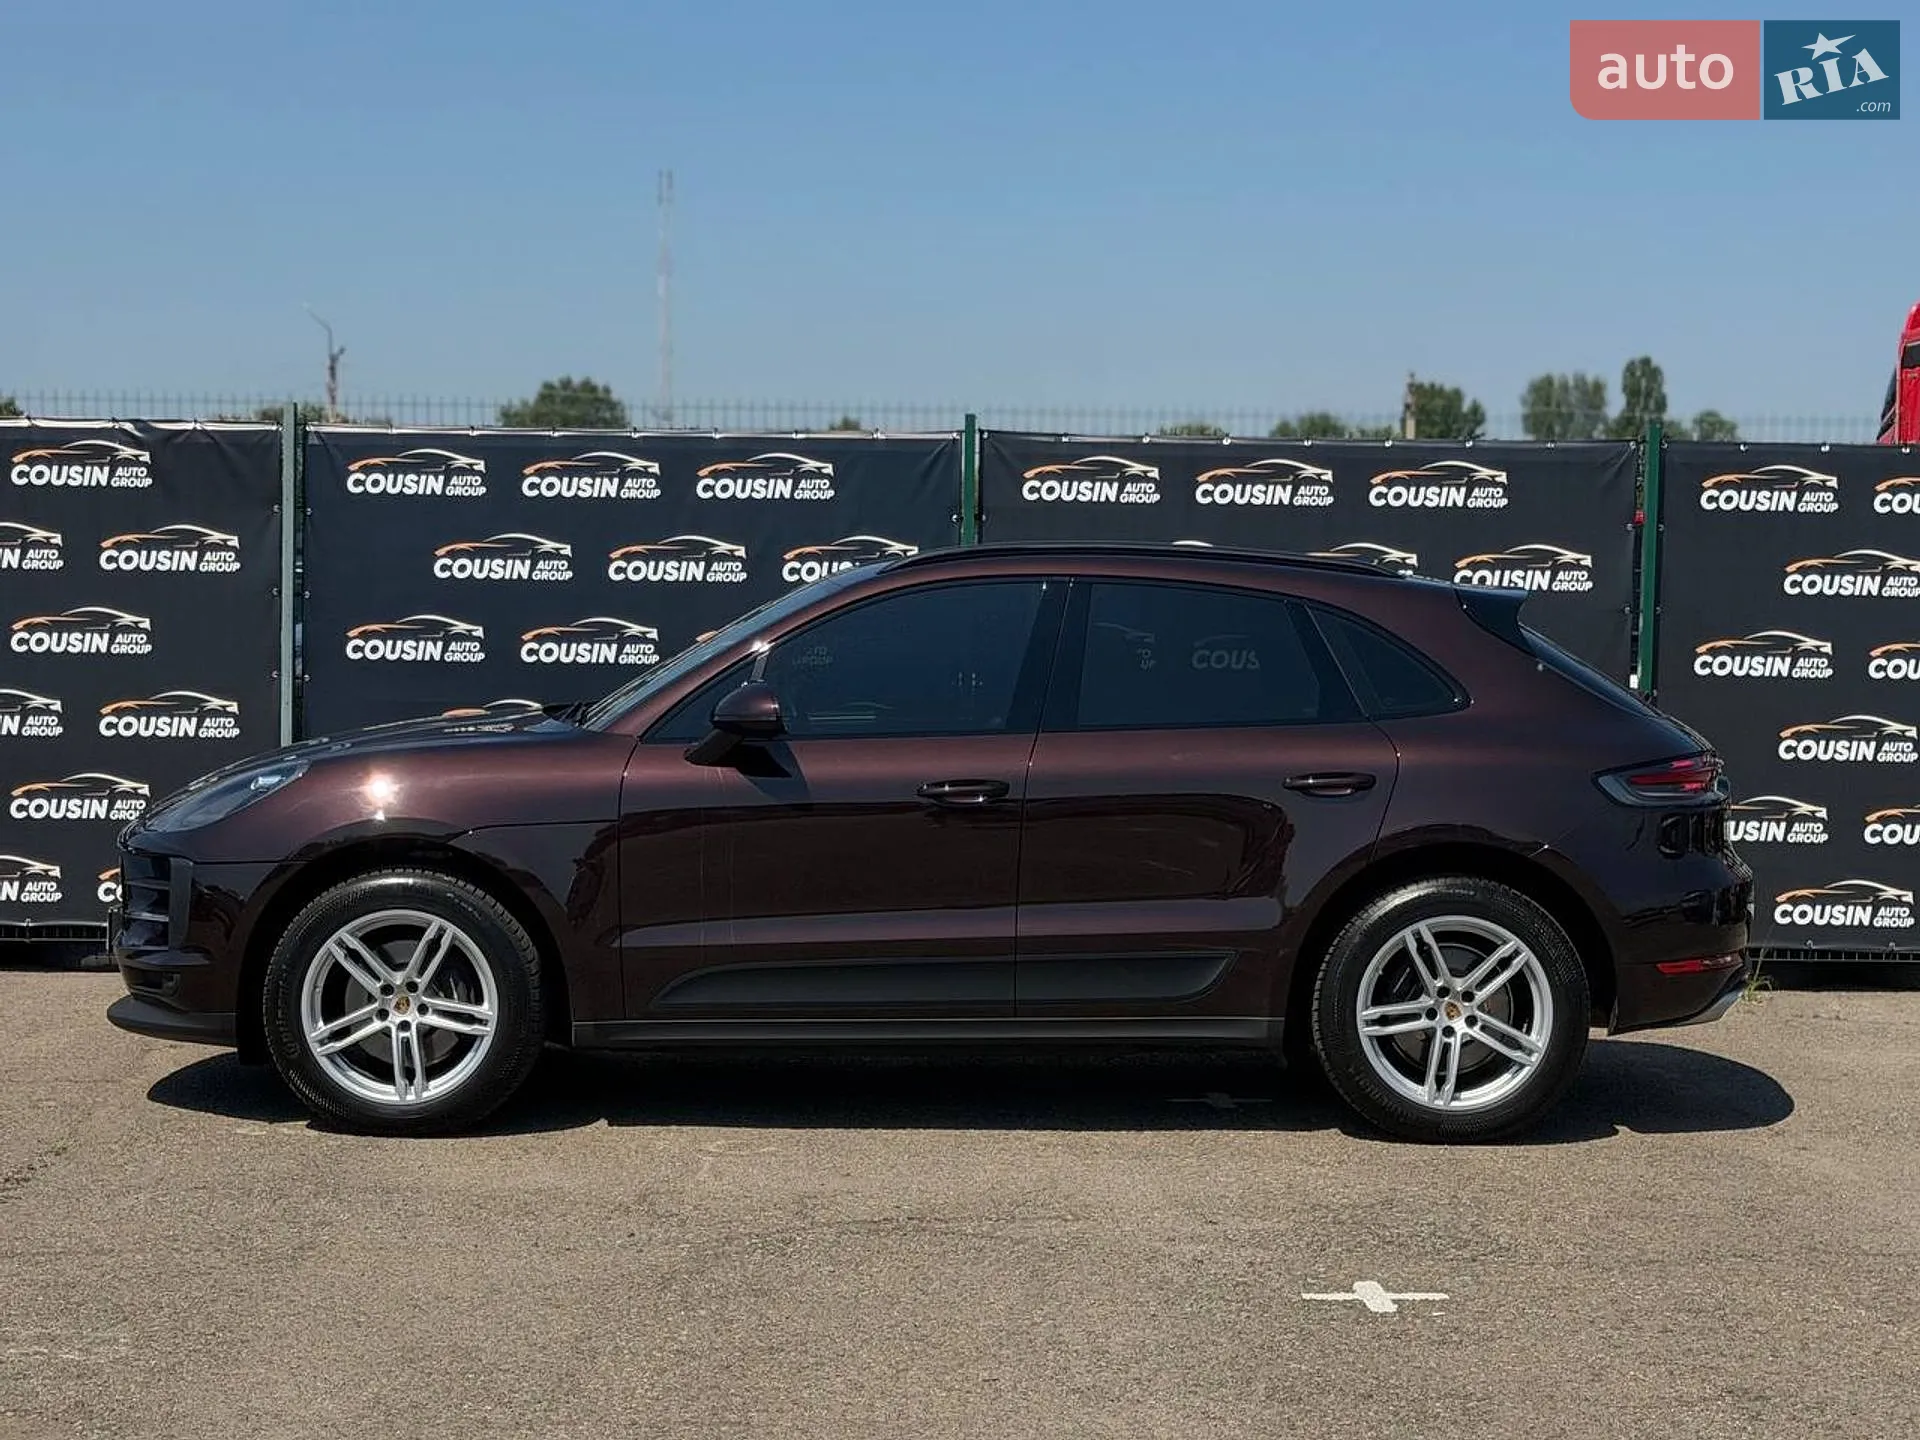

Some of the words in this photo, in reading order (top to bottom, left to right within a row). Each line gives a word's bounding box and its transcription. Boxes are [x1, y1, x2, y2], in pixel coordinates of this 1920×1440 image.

[11, 464, 109, 486] COUSIN
[114, 467, 147, 477] AUTO
[110, 477, 152, 488] GROUP
[347, 472, 445, 494] COUSIN
[450, 475, 483, 485] AUTO
[522, 475, 620, 497] COUSIN
[625, 478, 658, 488] AUTO
[696, 477, 794, 499] COUSIN
[799, 480, 832, 490] AUTO
[446, 485, 488, 496] GROUP
[621, 488, 663, 499] GROUP
[795, 490, 837, 501] GROUP
[1022, 480, 1120, 502] COUSIN
[1125, 483, 1158, 493] AUTO
[1195, 483, 1293, 505] COUSIN
[1298, 486, 1331, 496] AUTO
[1369, 485, 1467, 507] COUSIN
[1472, 488, 1505, 498] AUTO
[1121, 493, 1163, 504] GROUP
[1294, 496, 1336, 507] GROUP
[1468, 498, 1510, 509] GROUP
[1700, 488, 1798, 510] COUSIN
[1803, 491, 1836, 501] AUTO
[1799, 501, 1841, 512] GROUP
[26, 551, 59, 561] AUTO
[100, 548, 198, 570] COUSIN
[203, 551, 236, 561] AUTO
[22, 561, 64, 572] GROUP
[199, 561, 241, 572] GROUP
[434, 557, 532, 579] COUSIN
[537, 560, 570, 570] AUTO
[608, 559, 706, 581] COUSIN
[711, 562, 744, 572] AUTO
[533, 570, 575, 581] GROUP
[707, 572, 749, 583] GROUP
[1557, 572, 1590, 582] AUTO
[1553, 582, 1595, 593] GROUP
[1784, 573, 1882, 595] COUSIN
[1887, 576, 1920, 586] AUTO
[11, 631, 109, 653] COUSIN
[114, 634, 147, 644] AUTO
[110, 644, 152, 655] GROUP
[346, 638, 444, 660] COUSIN
[449, 641, 482, 651] AUTO
[520, 641, 618, 663] COUSIN
[623, 644, 656, 654] AUTO
[445, 651, 487, 662] GROUP
[619, 654, 661, 665] GROUP
[1694, 654, 1792, 676] COUSIN
[1797, 657, 1830, 667] AUTO
[1793, 667, 1835, 678] GROUP
[26, 717, 59, 727] AUTO
[100, 715, 198, 737] COUSIN
[203, 718, 236, 728] AUTO
[22, 727, 64, 738] GROUP
[199, 728, 241, 739] GROUP
[1778, 738, 1876, 760] COUSIN
[1881, 741, 1914, 751] AUTO
[1877, 751, 1919, 762] GROUP
[10, 797, 108, 819] COUSIN
[113, 800, 146, 810] AUTO
[1790, 823, 1823, 833] AUTO
[1786, 833, 1828, 844] GROUP
[25, 883, 58, 893] AUTO
[21, 893, 63, 904] GROUP
[1774, 904, 1872, 926] COUSIN
[1877, 907, 1910, 917] AUTO
[1873, 917, 1915, 928] GROUP
